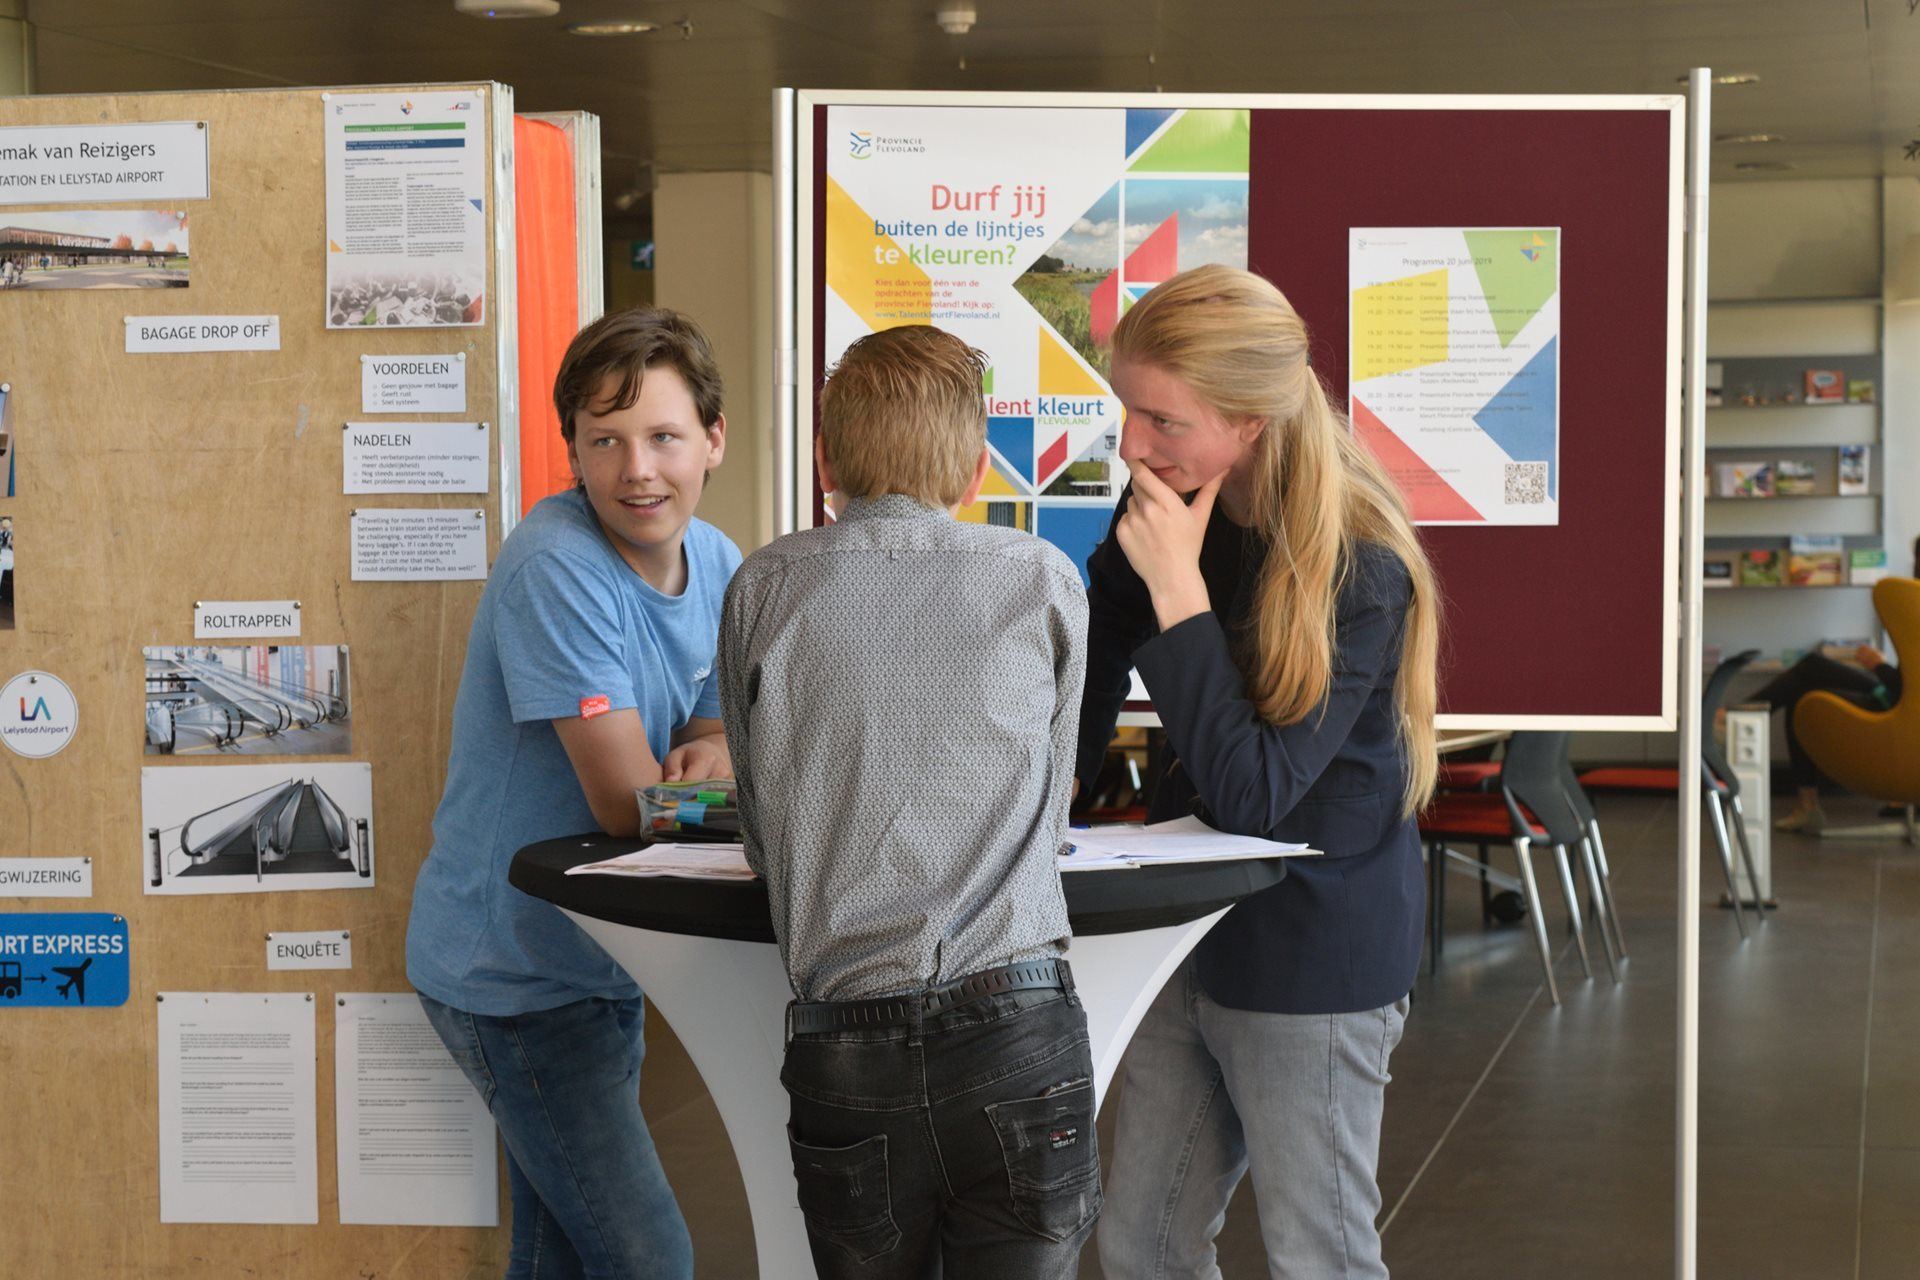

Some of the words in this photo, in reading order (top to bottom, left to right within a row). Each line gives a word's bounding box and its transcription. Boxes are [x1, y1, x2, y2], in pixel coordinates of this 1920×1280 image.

[876, 136, 922, 144] PROVINCIE
[0, 144, 38, 160] mak
[44, 146, 73, 160] van
[80, 142, 156, 161] Reizigers
[876, 145, 926, 153] FLEVOLAND
[41, 174, 56, 186] EN
[60, 172, 113, 185] LELYSTAD
[116, 171, 164, 184] AIRPORT
[931, 184, 1002, 212] Durf
[1011, 185, 1046, 218] jij
[874, 220, 938, 236] buiten
[944, 221, 968, 236] de
[976, 221, 1045, 241] lijntjes
[874, 245, 899, 264] te
[908, 244, 1016, 265] kleuren?
[1402, 258, 1444, 267] Programma
[968, 280, 979, 288] de
[874, 290, 922, 298] opdrachten
[874, 300, 914, 309] provincie
[916, 300, 960, 308] Flevoland!
[962, 301, 979, 309] Kijk
[141, 326, 196, 340] BAGAGE
[201, 325, 238, 340] DROP
[244, 324, 270, 338] OFF
[372, 362, 449, 376] VOORDELEN
[1038, 397, 1104, 416] kleurt
[1038, 417, 1091, 425] FLEVOLAND
[353, 434, 411, 446] NADELEN
[204, 614, 292, 628] ROLTRAPPEN
[4, 726, 38, 736] Lelystad
[40, 726, 68, 736] Airport
[0, 870, 82, 884] GWIJZERING
[0, 934, 29, 954] RT
[32, 934, 124, 954] EXPRESS
[277, 940, 341, 959] ENQUÊTE
